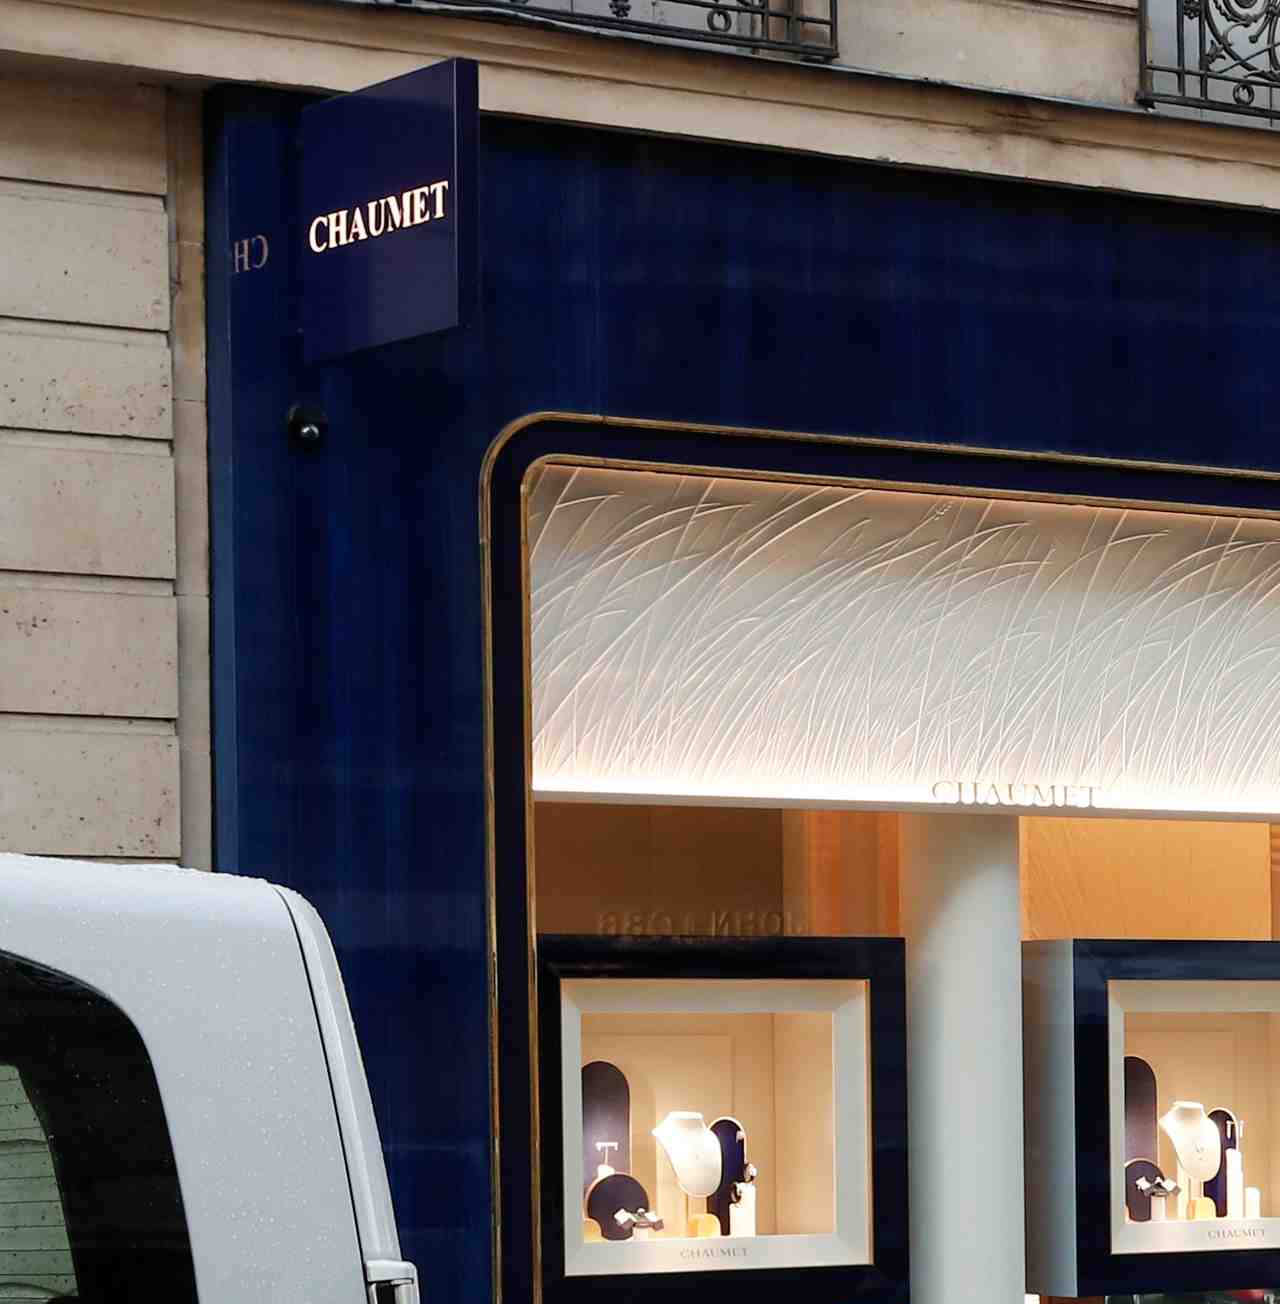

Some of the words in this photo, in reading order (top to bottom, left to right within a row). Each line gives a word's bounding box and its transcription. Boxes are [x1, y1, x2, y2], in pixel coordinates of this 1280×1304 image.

[308, 180, 449, 253] CHAUMET
[931, 779, 1102, 809] CHAUMET
[679, 1247, 752, 1258] CHAUMET
